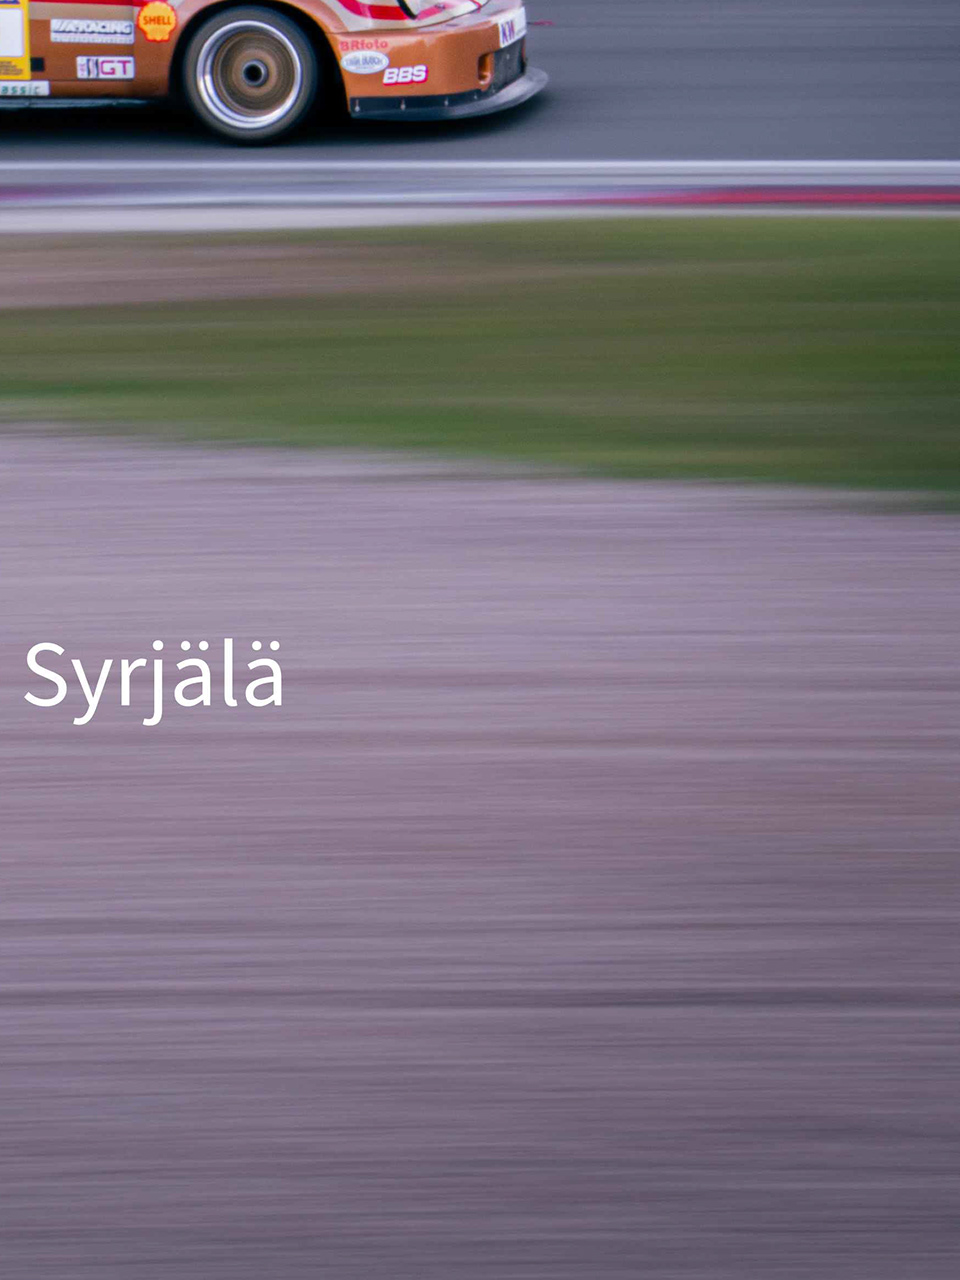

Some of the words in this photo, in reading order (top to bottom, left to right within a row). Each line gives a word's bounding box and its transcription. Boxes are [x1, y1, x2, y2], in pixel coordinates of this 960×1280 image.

[143, 15, 172, 26] SHELL
[100, 60, 132, 75] GT
[383, 64, 428, 85] BBS
